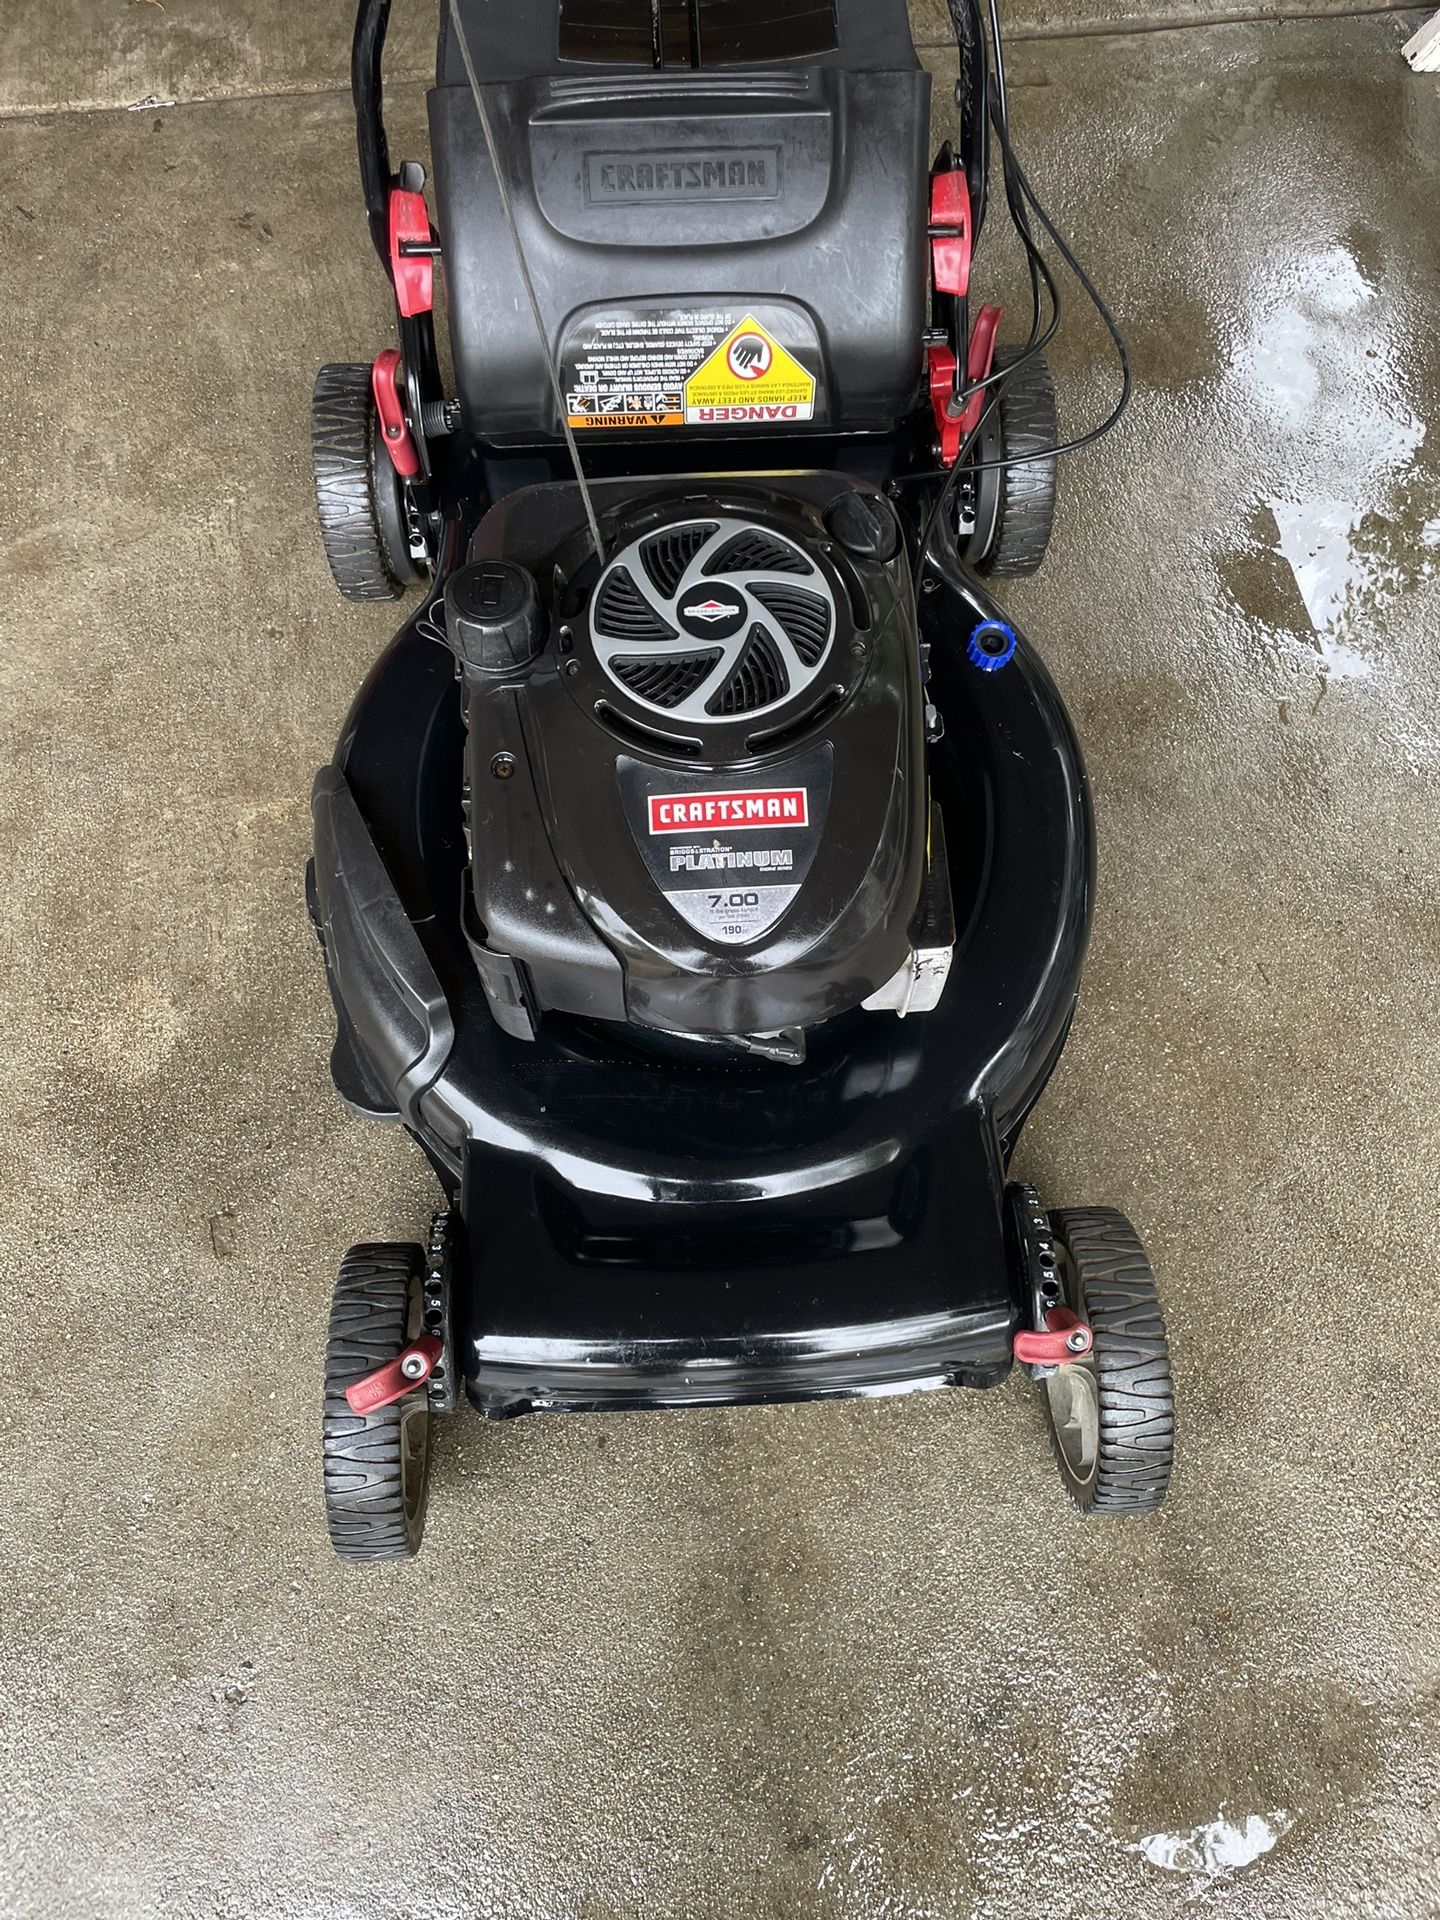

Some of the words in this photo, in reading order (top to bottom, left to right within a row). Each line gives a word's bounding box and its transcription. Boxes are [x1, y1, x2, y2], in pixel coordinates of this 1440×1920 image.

[600, 160, 765, 192] CRAFTSMAN
[598, 384, 608, 392] OR
[610, 384, 632, 392] INJURY
[634, 383, 662, 391] SERIOUS
[664, 382, 683, 390] AVOID
[699, 406, 797, 421] DANGER
[586, 416, 647, 425] WARNING
[660, 798, 797, 824] CRAFTSMAN
[670, 850, 793, 871] PLATINUM
[708, 893, 758, 908] 7.00
[1039, 1242, 1049, 1250] 4
[1043, 1271, 1054, 1279] 5
[431, 1299, 441, 1307] 5
[1046, 1300, 1056, 1308] 6
